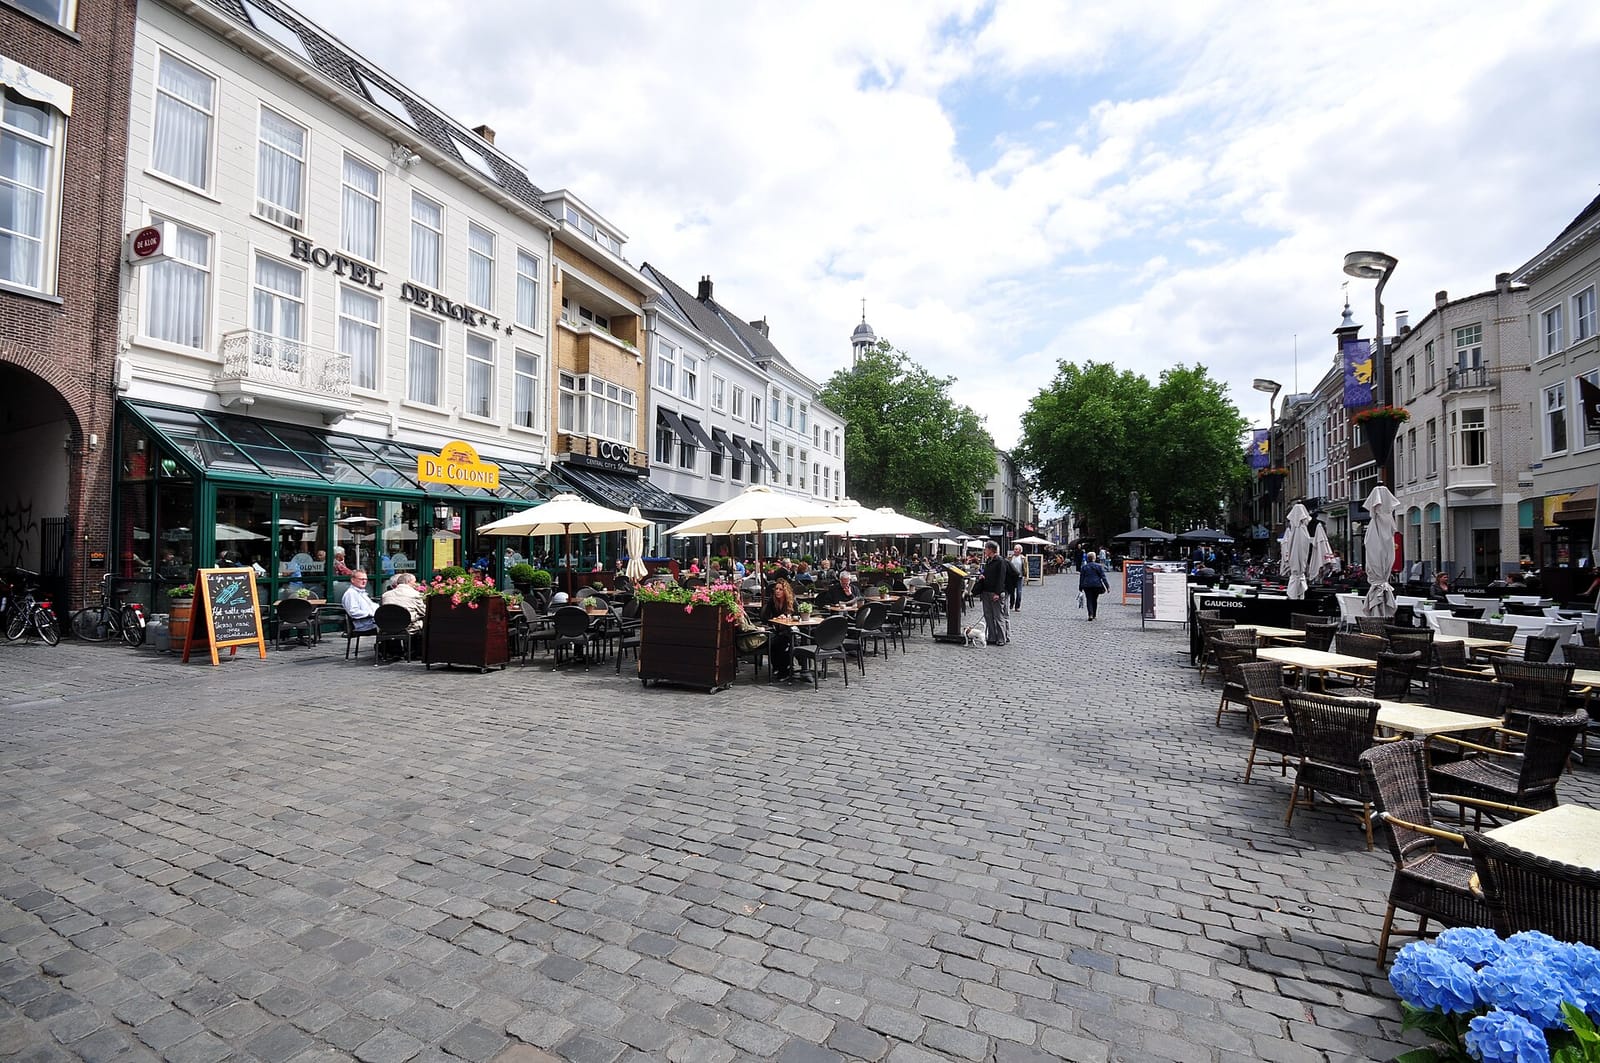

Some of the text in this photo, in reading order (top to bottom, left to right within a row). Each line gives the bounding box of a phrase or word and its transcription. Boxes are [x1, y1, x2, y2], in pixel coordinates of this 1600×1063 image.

[137, 237, 157, 249] DE KLOK
[289, 236, 384, 290] HOTEL
[400, 282, 478, 327] DE KLOK
[601, 441, 629, 463] CC'S
